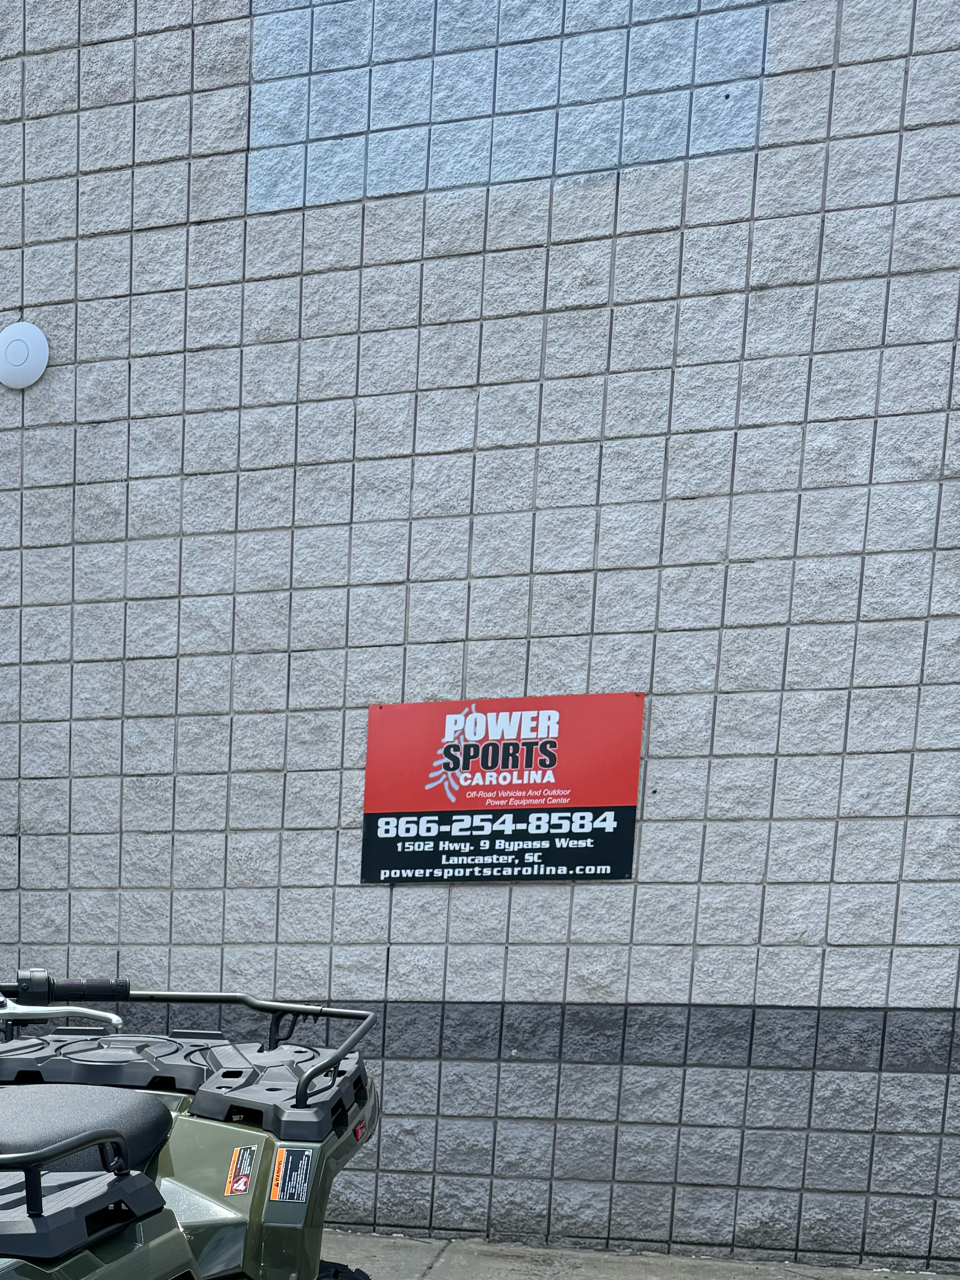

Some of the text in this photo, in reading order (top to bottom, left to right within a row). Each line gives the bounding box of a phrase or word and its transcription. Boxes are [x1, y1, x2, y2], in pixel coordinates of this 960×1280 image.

[445, 710, 559, 742] POWER
[442, 739, 558, 772] SPORTS
[460, 770, 556, 786] CAROLINA
[498, 790, 526, 798] Vehicles
[527, 789, 541, 797] And
[543, 788, 571, 796] Outdoor
[486, 797, 570, 807] Power Equipment Center
[377, 811, 618, 838] 866-254-8584
[396, 838, 594, 853] 1502 Hwy. 9 Bypass West
[441, 852, 543, 865] Lancaster, SC
[380, 864, 612, 881] powersportscarolina.com
